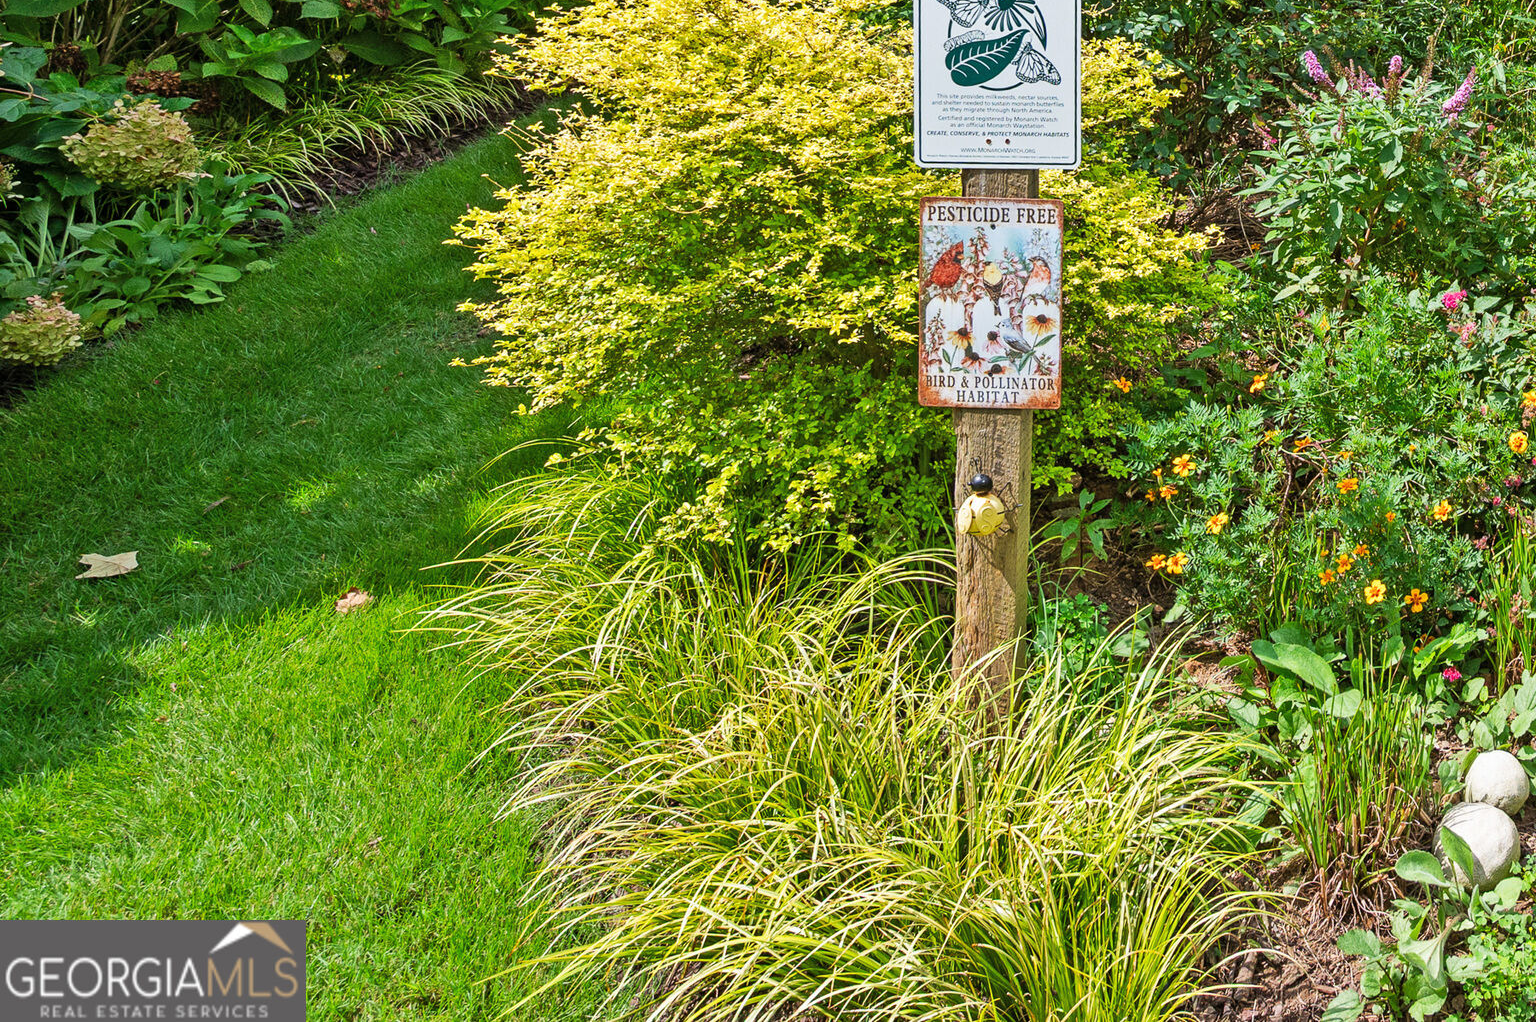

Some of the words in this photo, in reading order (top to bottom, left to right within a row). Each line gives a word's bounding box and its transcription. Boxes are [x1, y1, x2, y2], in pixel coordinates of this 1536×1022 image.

[927, 205, 1010, 223] PESTICIDE
[1017, 207, 1056, 224] FREE
[926, 375, 956, 388] BIRD
[961, 377, 969, 389] &
[974, 377, 1055, 391] POLLINATOR
[956, 390, 1020, 404] HABITAT
